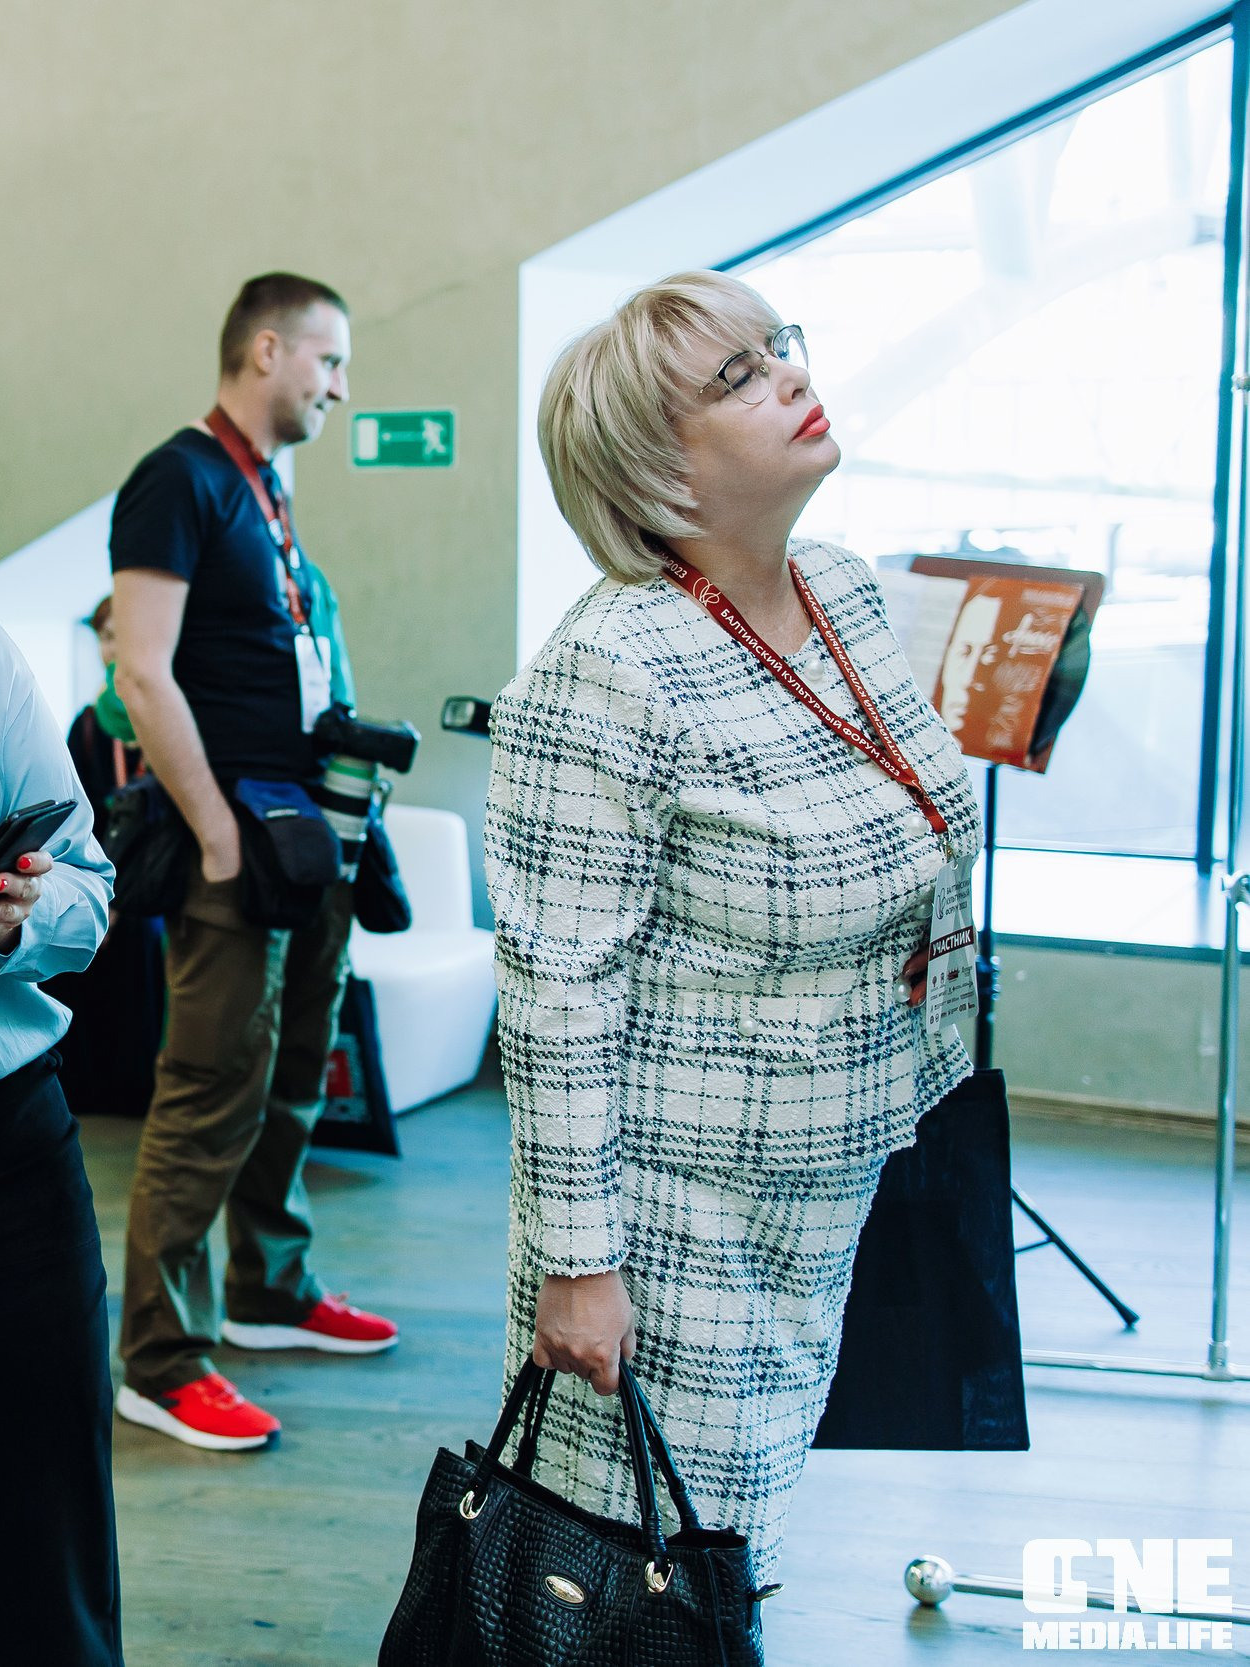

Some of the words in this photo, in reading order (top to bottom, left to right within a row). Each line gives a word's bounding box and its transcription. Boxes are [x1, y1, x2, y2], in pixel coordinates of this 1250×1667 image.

[667, 560, 688, 579] 2023
[805, 591, 829, 629] ФОРУМ
[824, 630, 866, 700] КУЛЬТУРНЫЙ
[720, 608, 783, 673] БАЛТИЙСКИЙ
[780, 669, 842, 729] КУЛЬТУРНЫЙ
[842, 726, 881, 760] ФОРУМ
[879, 757, 901, 777] 2023
[863, 698, 909, 770] БАЛТИЙСКИЙ
[932, 929, 972, 957] УЧАСТНИК
